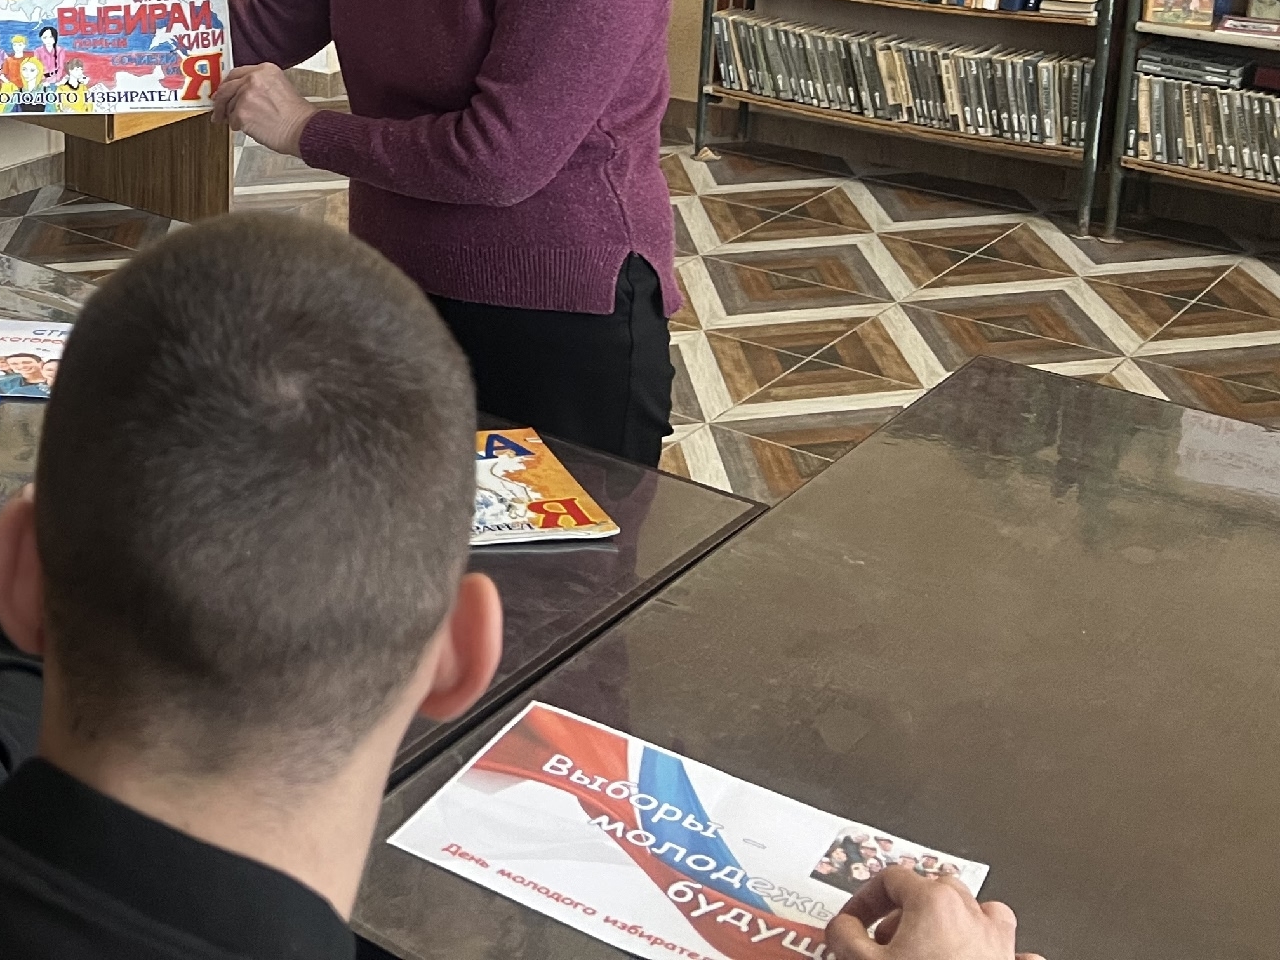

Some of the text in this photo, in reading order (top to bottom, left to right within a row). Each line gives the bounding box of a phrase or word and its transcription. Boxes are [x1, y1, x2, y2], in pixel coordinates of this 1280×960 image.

[174, 29, 225, 51] ЖИВИ
[32, 329, 69, 337] СТР
[542, 753, 725, 839] Выборы
[441, 841, 717, 960] День молодого избирател
[588, 814, 835, 923] молодежь
[666, 880, 836, 960] будущ
